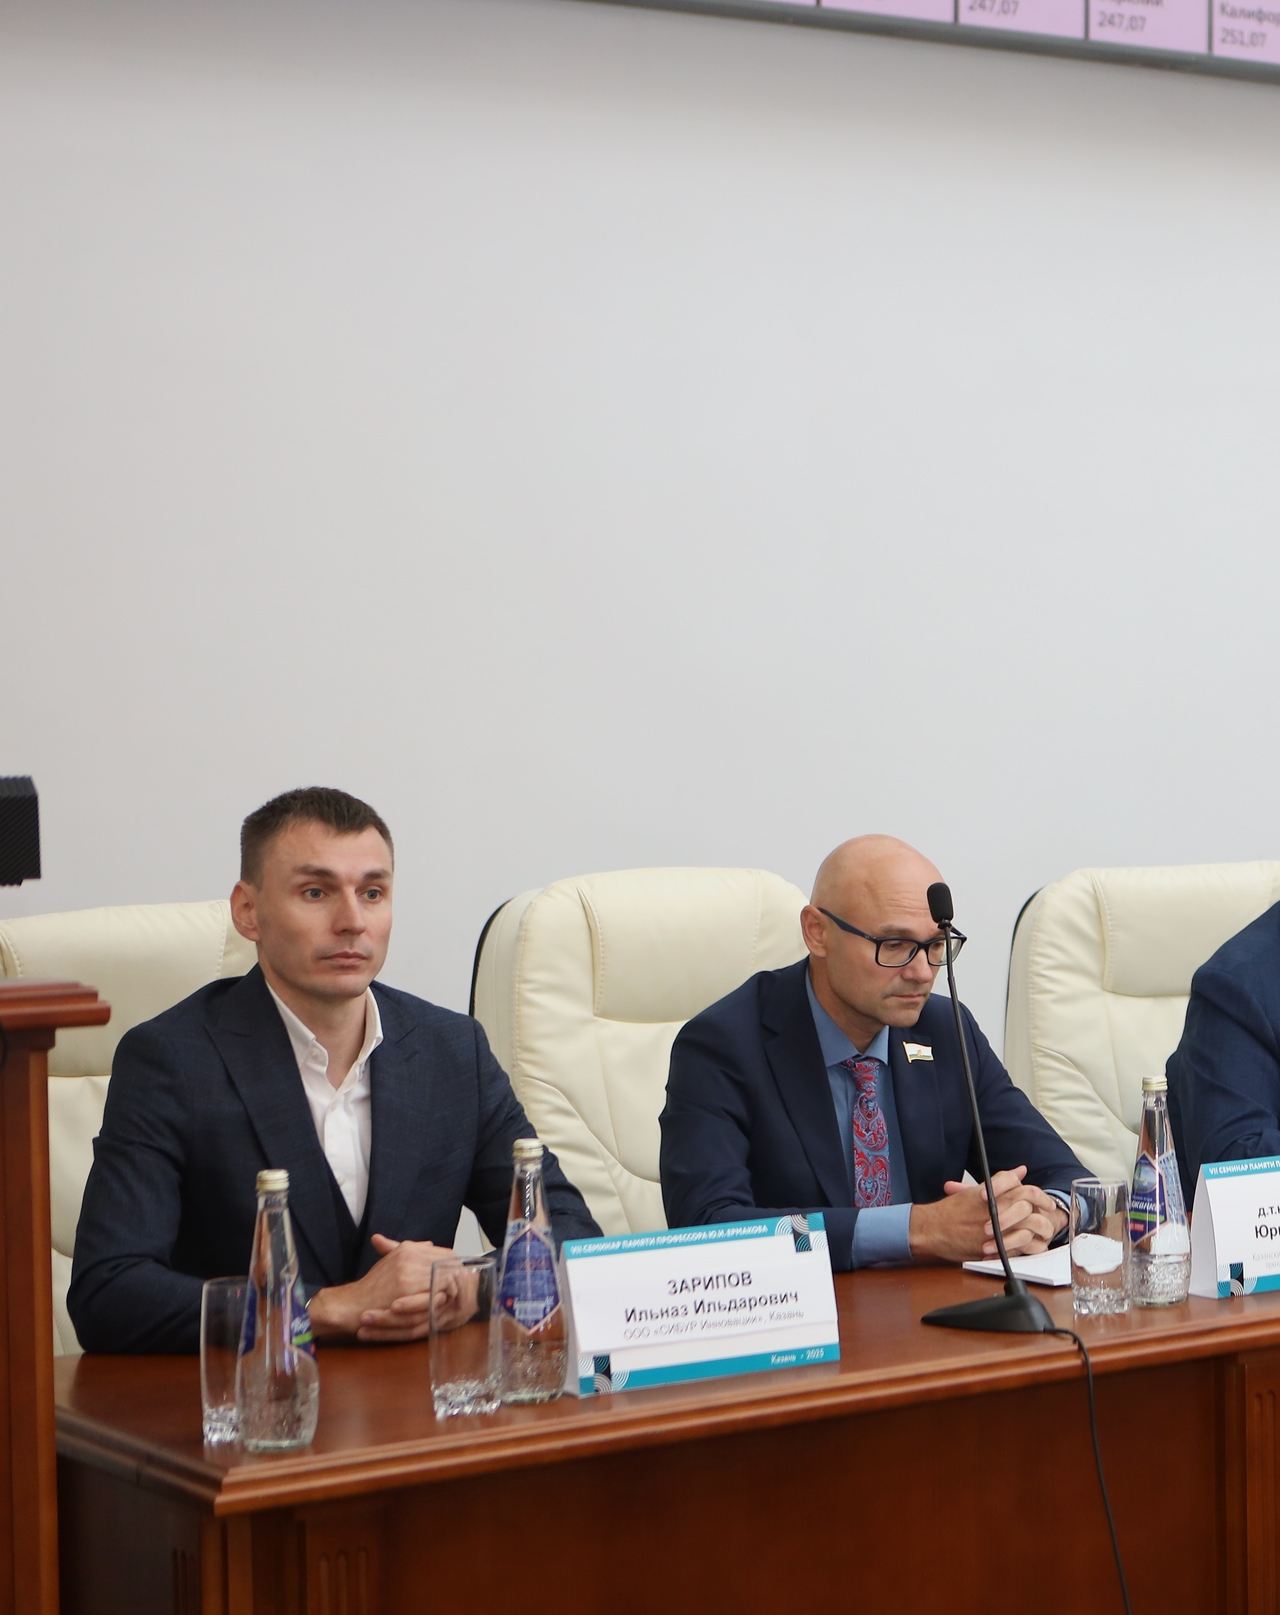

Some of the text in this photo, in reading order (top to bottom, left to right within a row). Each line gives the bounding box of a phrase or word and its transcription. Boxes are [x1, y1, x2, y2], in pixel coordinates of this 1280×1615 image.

[1208, 1167, 1218, 1175] VII
[1219, 1163, 1249, 1174] СЕМИНАР
[1249, 1161, 1275, 1171] ПАМЯТИ
[583, 1241, 622, 1254] СЕМИНАР
[622, 1238, 655, 1250] ПАМЯТИ
[655, 1231, 708, 1246] ПРОФЕССОРА
[726, 1224, 769, 1238] ЕРМАКОВА
[667, 1271, 753, 1296] ЗАРИПОВ
[624, 1291, 799, 1324] Ильназ Ильдарович
[623, 1326, 651, 1341] ООО
[769, 1309, 805, 1322] Казань
[770, 1348, 825, 1365] Казань 2025
